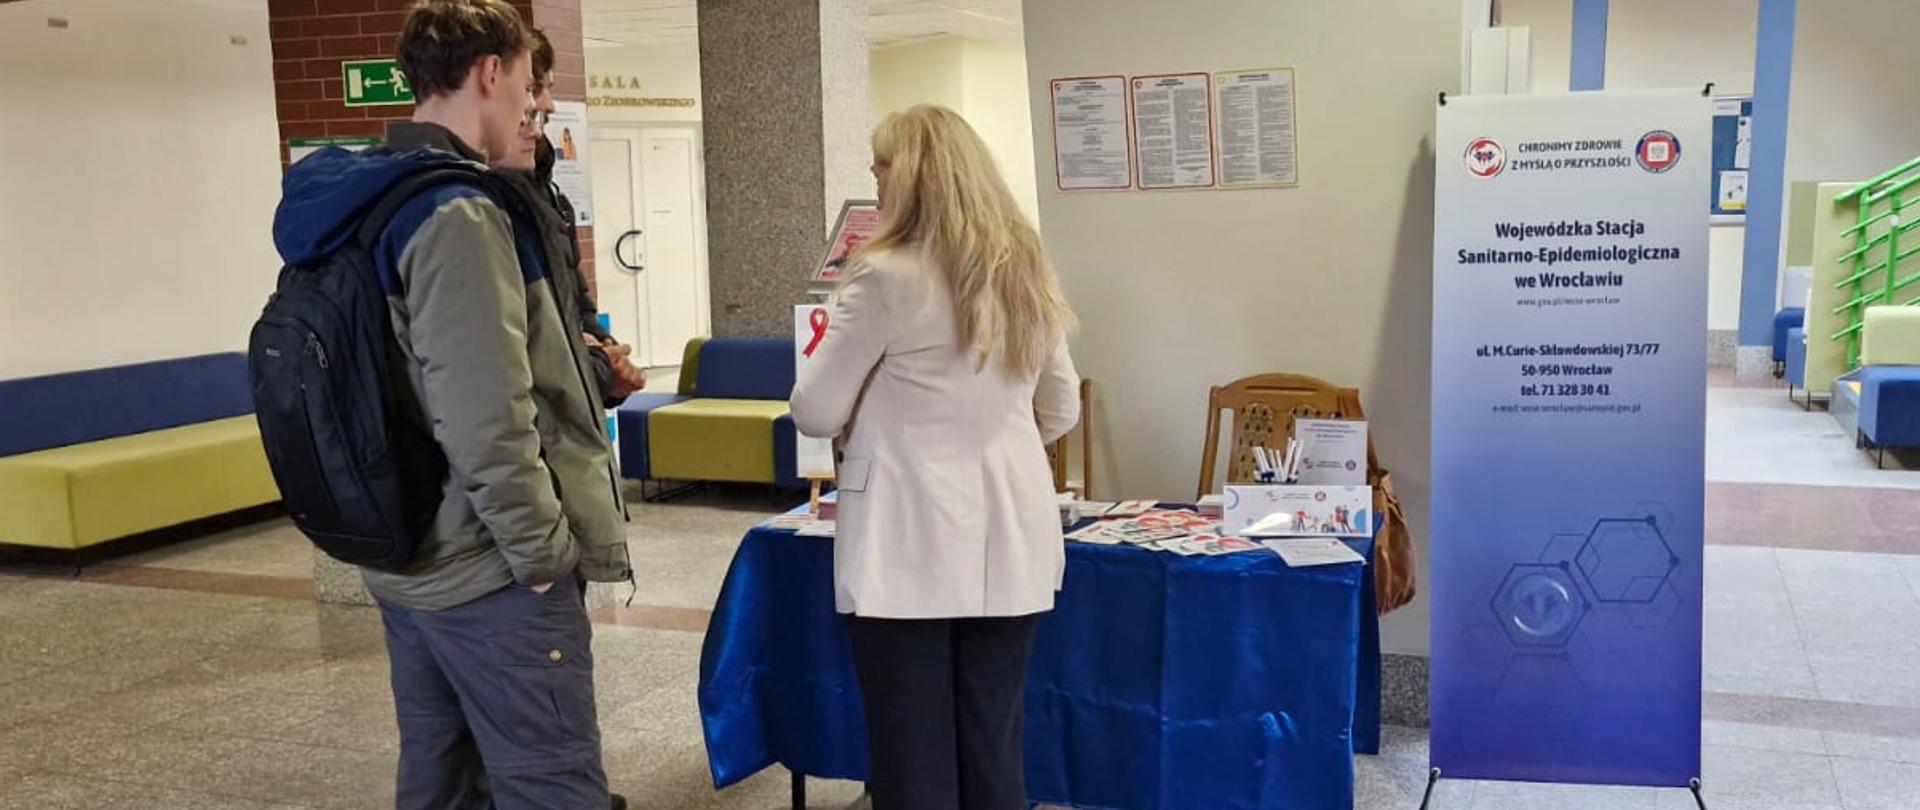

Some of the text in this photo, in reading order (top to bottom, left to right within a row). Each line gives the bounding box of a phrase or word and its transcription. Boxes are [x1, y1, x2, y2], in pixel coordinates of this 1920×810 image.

[590, 76, 641, 89] SALA
[1518, 140, 1622, 153] CHRONIMY ZDROWIE
[1511, 155, 1631, 171] Z MYŚLĄ O PRZYSZŁOŚCI
[1495, 219, 1645, 241] Wojewódzka Stacja
[1458, 245, 1680, 266] Sanitarno-Epidemiologiczna
[1515, 271, 1623, 288] we Wrocławiu
[1626, 343, 1660, 355] 73/77
[1521, 363, 1613, 376] 50-950 Wrocław
[1520, 384, 1611, 396] tel. 71 328 30 41
